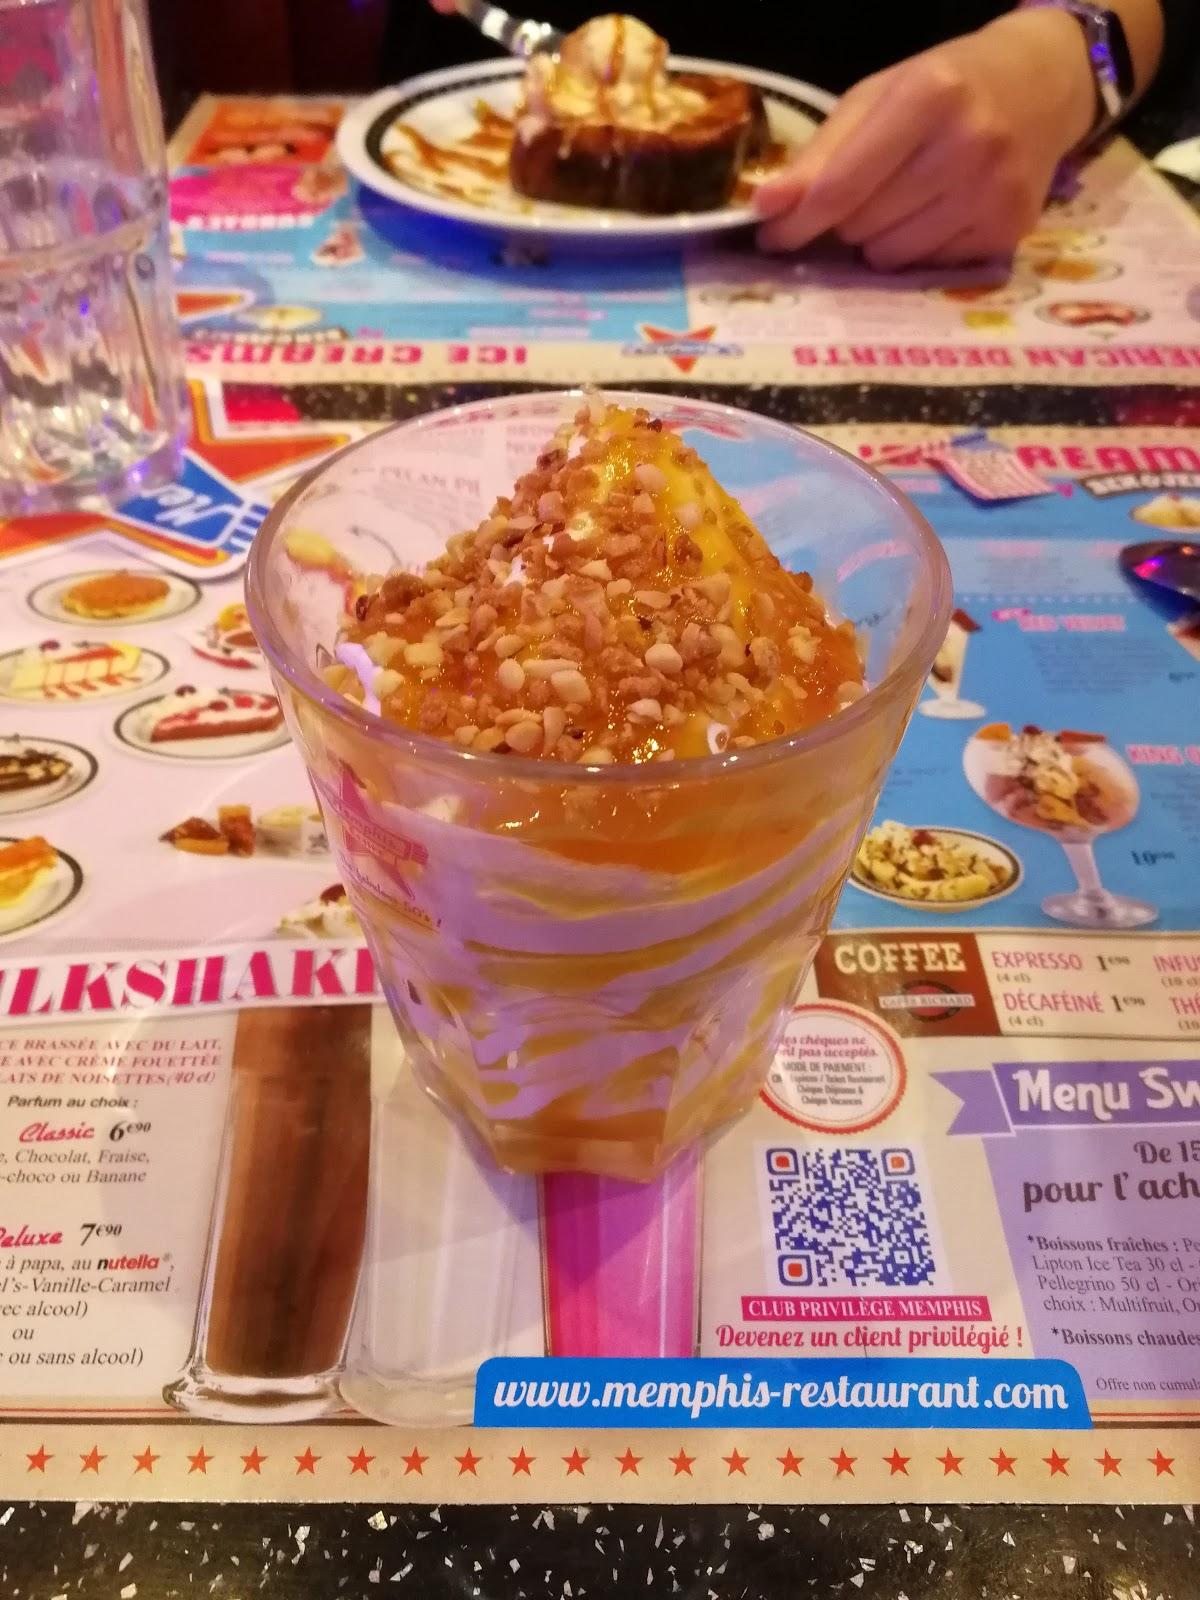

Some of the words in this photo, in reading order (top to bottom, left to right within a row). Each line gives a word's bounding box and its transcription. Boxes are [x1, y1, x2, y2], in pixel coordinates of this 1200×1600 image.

[448, 345, 527, 364] ICE
[793, 347, 1013, 368] DESSERTS
[834, 943, 967, 974] COFFEE
[992, 951, 1082, 970] EXPRESSO
[1153, 954, 1200, 972] INFU
[1004, 990, 1104, 1013] DÉCAFÉINÉ
[23, 1037, 98, 1050] BRASSÉE
[152, 1040, 176, 1051] DU
[851, 1037, 866, 1045] ne
[131, 1054, 221, 1067] FOUETTÉE
[798, 1048, 821, 1060] pas
[41, 1073, 65, 1084] DE
[7, 1095, 62, 1109] Parfum
[67, 1098, 86, 1108] au
[90, 1096, 129, 1109] choix
[1012, 1068, 1131, 1121] Menu
[19, 1121, 95, 1144] Classic
[15, 1149, 92, 1164] Chocolat,
[98, 1149, 151, 1164] Fraise,
[1133, 1140, 1172, 1164] De
[60, 1173, 82, 1183] ou
[86, 1169, 147, 1184] Banane
[1023, 1180, 1103, 1213] pour
[1106, 1236, 1169, 1253] fraîches
[6, 1255, 15, 1270] à
[19, 1258, 65, 1274] papa,
[71, 1260, 92, 1271] au
[1033, 1255, 1083, 1273] Lipton
[1088, 1256, 1110, 1271] Ice
[1113, 1257, 1142, 1271] Tea
[1146, 1256, 1165, 1272] 30
[1170, 1257, 1184, 1272] cl
[1038, 1274, 1116, 1295] Pellegrino
[1121, 1276, 1140, 1292] 50
[1146, 1277, 1160, 1292] cl
[26, 1300, 89, 1319] alcool)
[748, 1299, 796, 1317] CLUB
[800, 1296, 896, 1317] PRIVILÈGE
[899, 1299, 982, 1317] MEMPHIS
[1043, 1296, 1087, 1312] choix
[12, 1328, 35, 1341] ou
[715, 1323, 804, 1348] Devenez
[811, 1329, 839, 1347] un
[843, 1324, 902, 1348] client
[908, 1322, 1010, 1354] privilégié
[9, 1352, 31, 1365] ou
[36, 1352, 76, 1366] sans
[81, 1348, 144, 1367] alcool)
[1096, 1377, 1130, 1391] Offre
[1133, 1381, 1156, 1391] non
[493, 1372, 1069, 1419] www.memphis-restaurant.com
